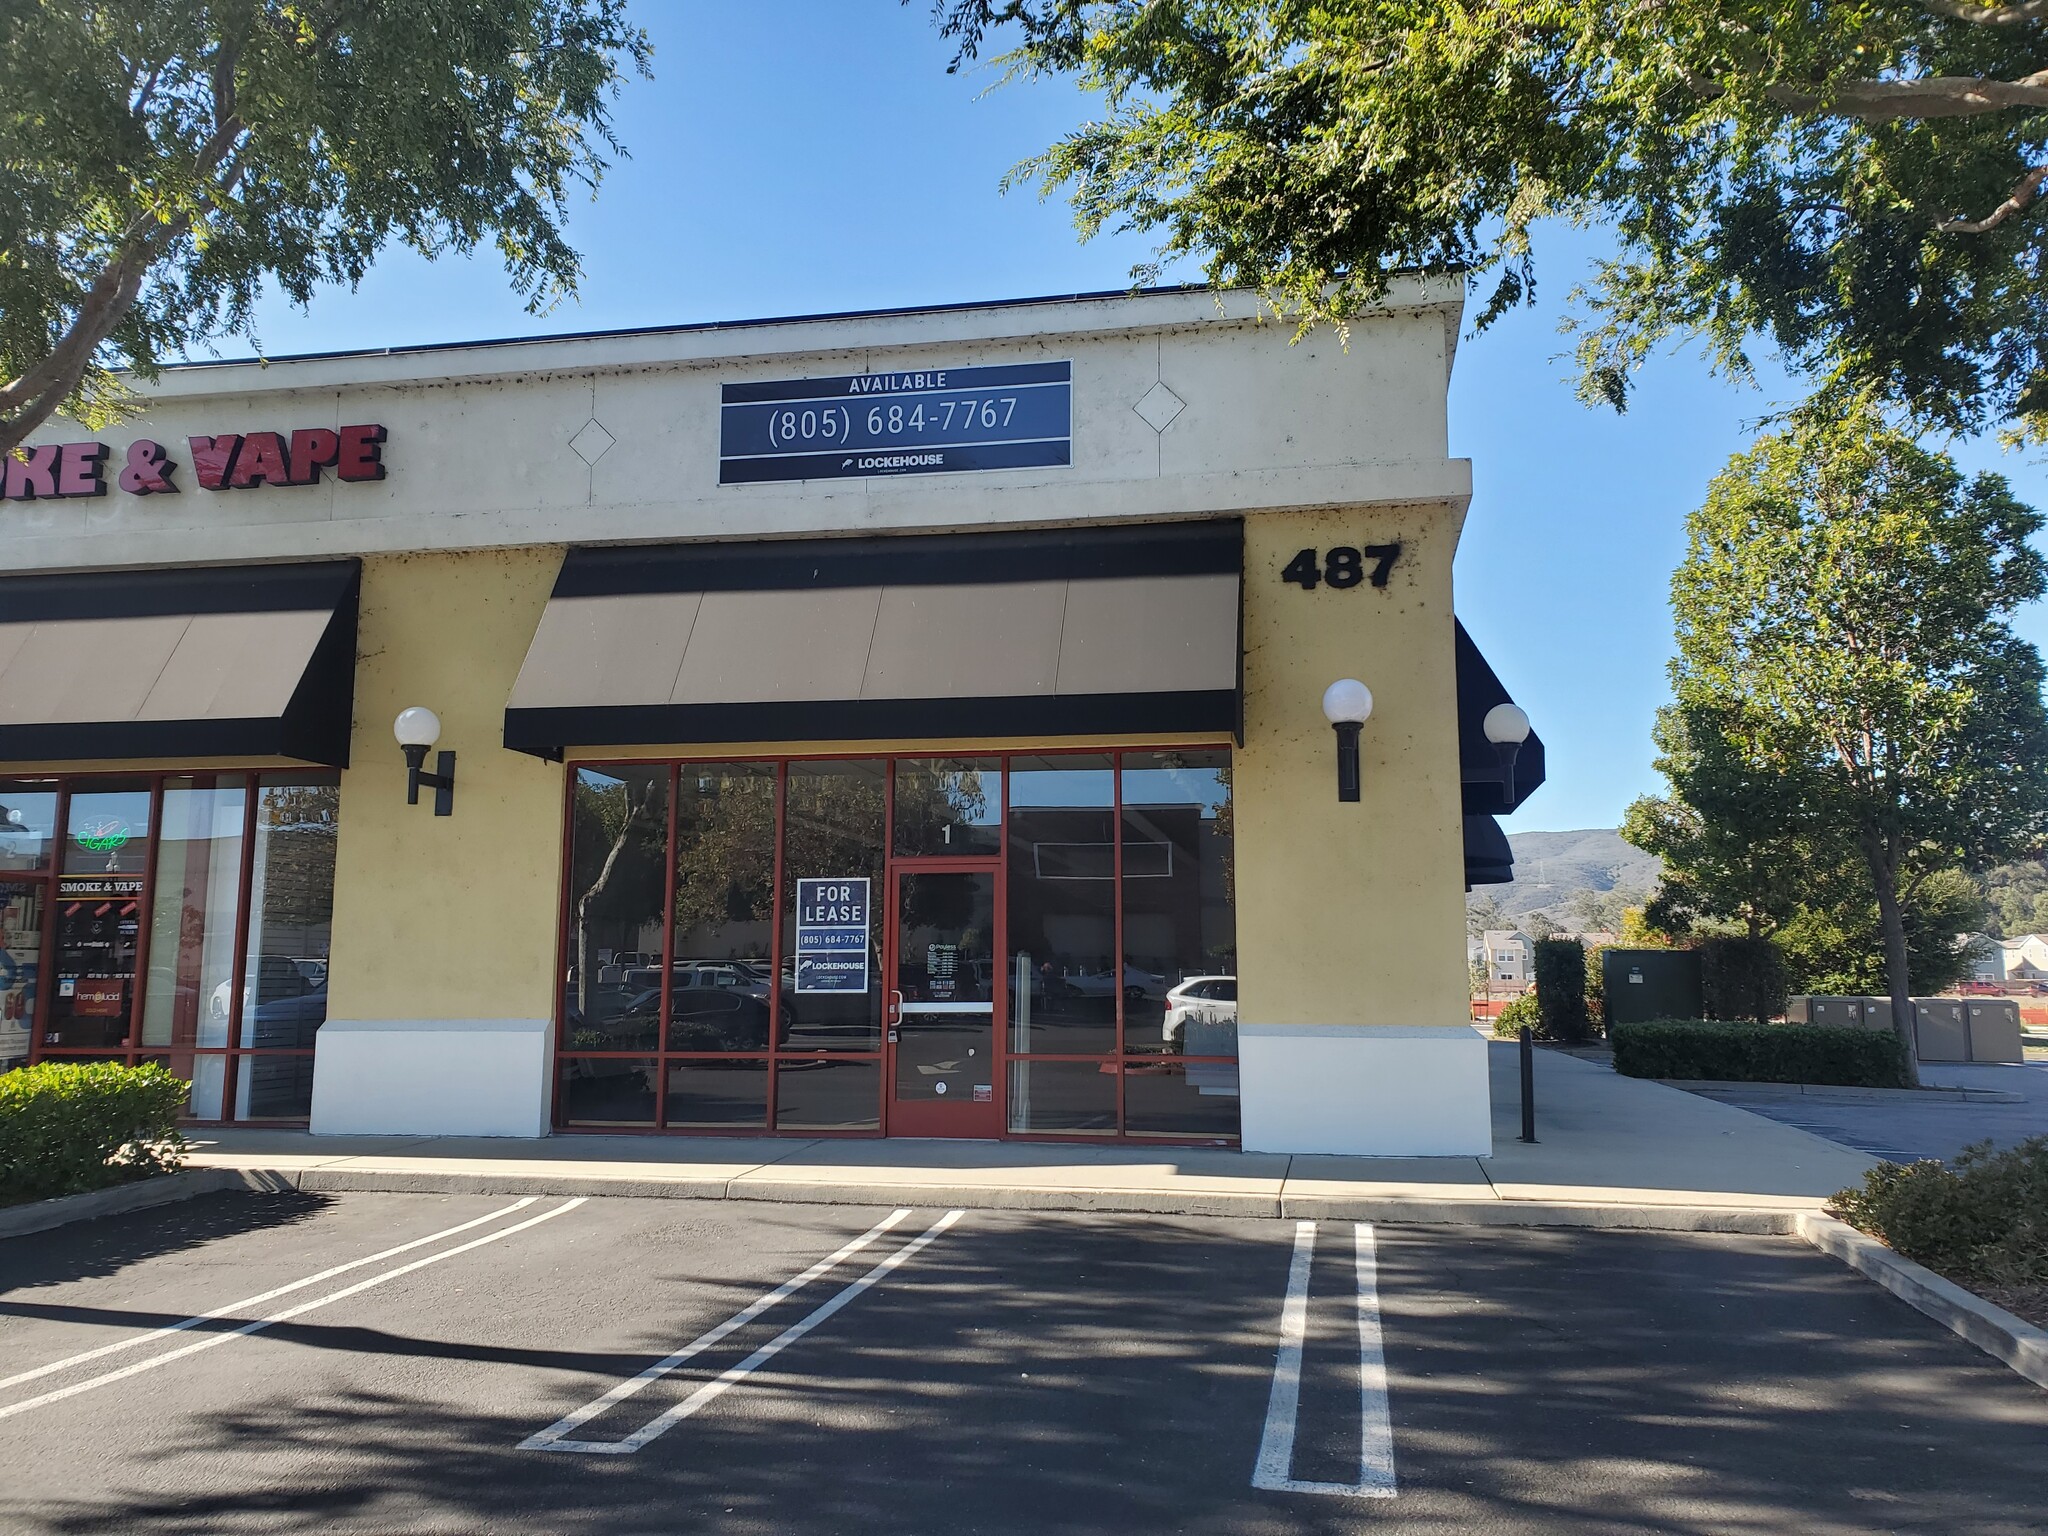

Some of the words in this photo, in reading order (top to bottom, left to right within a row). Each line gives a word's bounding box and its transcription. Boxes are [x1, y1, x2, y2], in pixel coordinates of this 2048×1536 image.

[849, 372, 947, 393] AVAILABLE
[768, 405, 851, 449] (805)
[867, 397, 1017, 435] 684-7767
[0, 442, 110, 501] KE
[118, 439, 181, 496] &
[187, 423, 388, 491] VAPE
[858, 453, 944, 469] LOCKEHOUSE
[1281, 543, 1402, 590] 487
[78, 827, 128, 851] CIGARS
[941, 824, 951, 844] 1
[60, 882, 102, 892] SMOKE
[103, 882, 113, 892] &
[114, 881, 143, 892] VAPE
[816, 886, 851, 902] FOR
[805, 905, 862, 922] LEASE
[800, 935, 823, 946] (805)
[825, 934, 865, 944] 684-7767
[812, 962, 865, 970] LOCKEHOUSE
